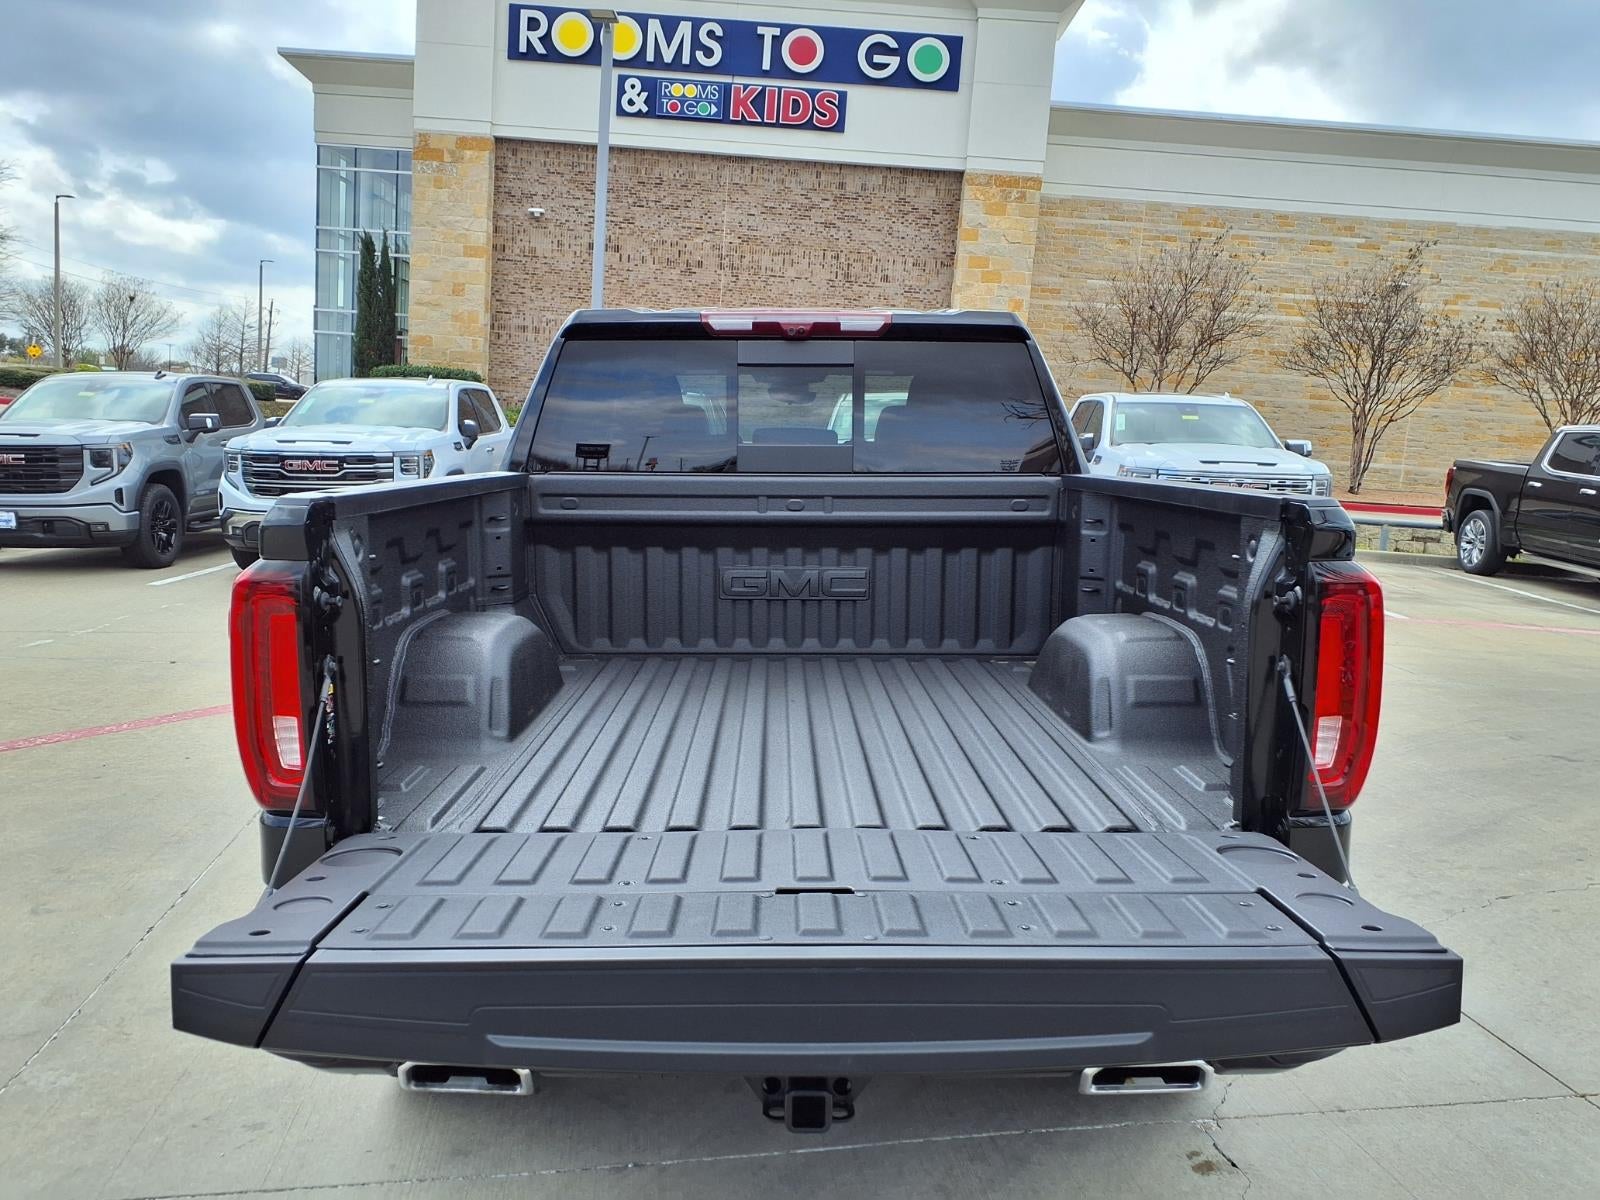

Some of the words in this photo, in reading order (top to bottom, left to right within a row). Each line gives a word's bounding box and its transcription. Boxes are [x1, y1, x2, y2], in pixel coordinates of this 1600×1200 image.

[519, 8, 724, 67] ROOMS
[757, 26, 824, 74] TO
[857, 33, 950, 83] GO
[620, 77, 649, 113] &
[661, 82, 719, 99] ROOMS
[663, 99, 681, 114] TO
[684, 101, 711, 116] GO
[729, 84, 839, 128] KIDS
[284, 460, 339, 471] GMC
[721, 569, 867, 598] GMC
